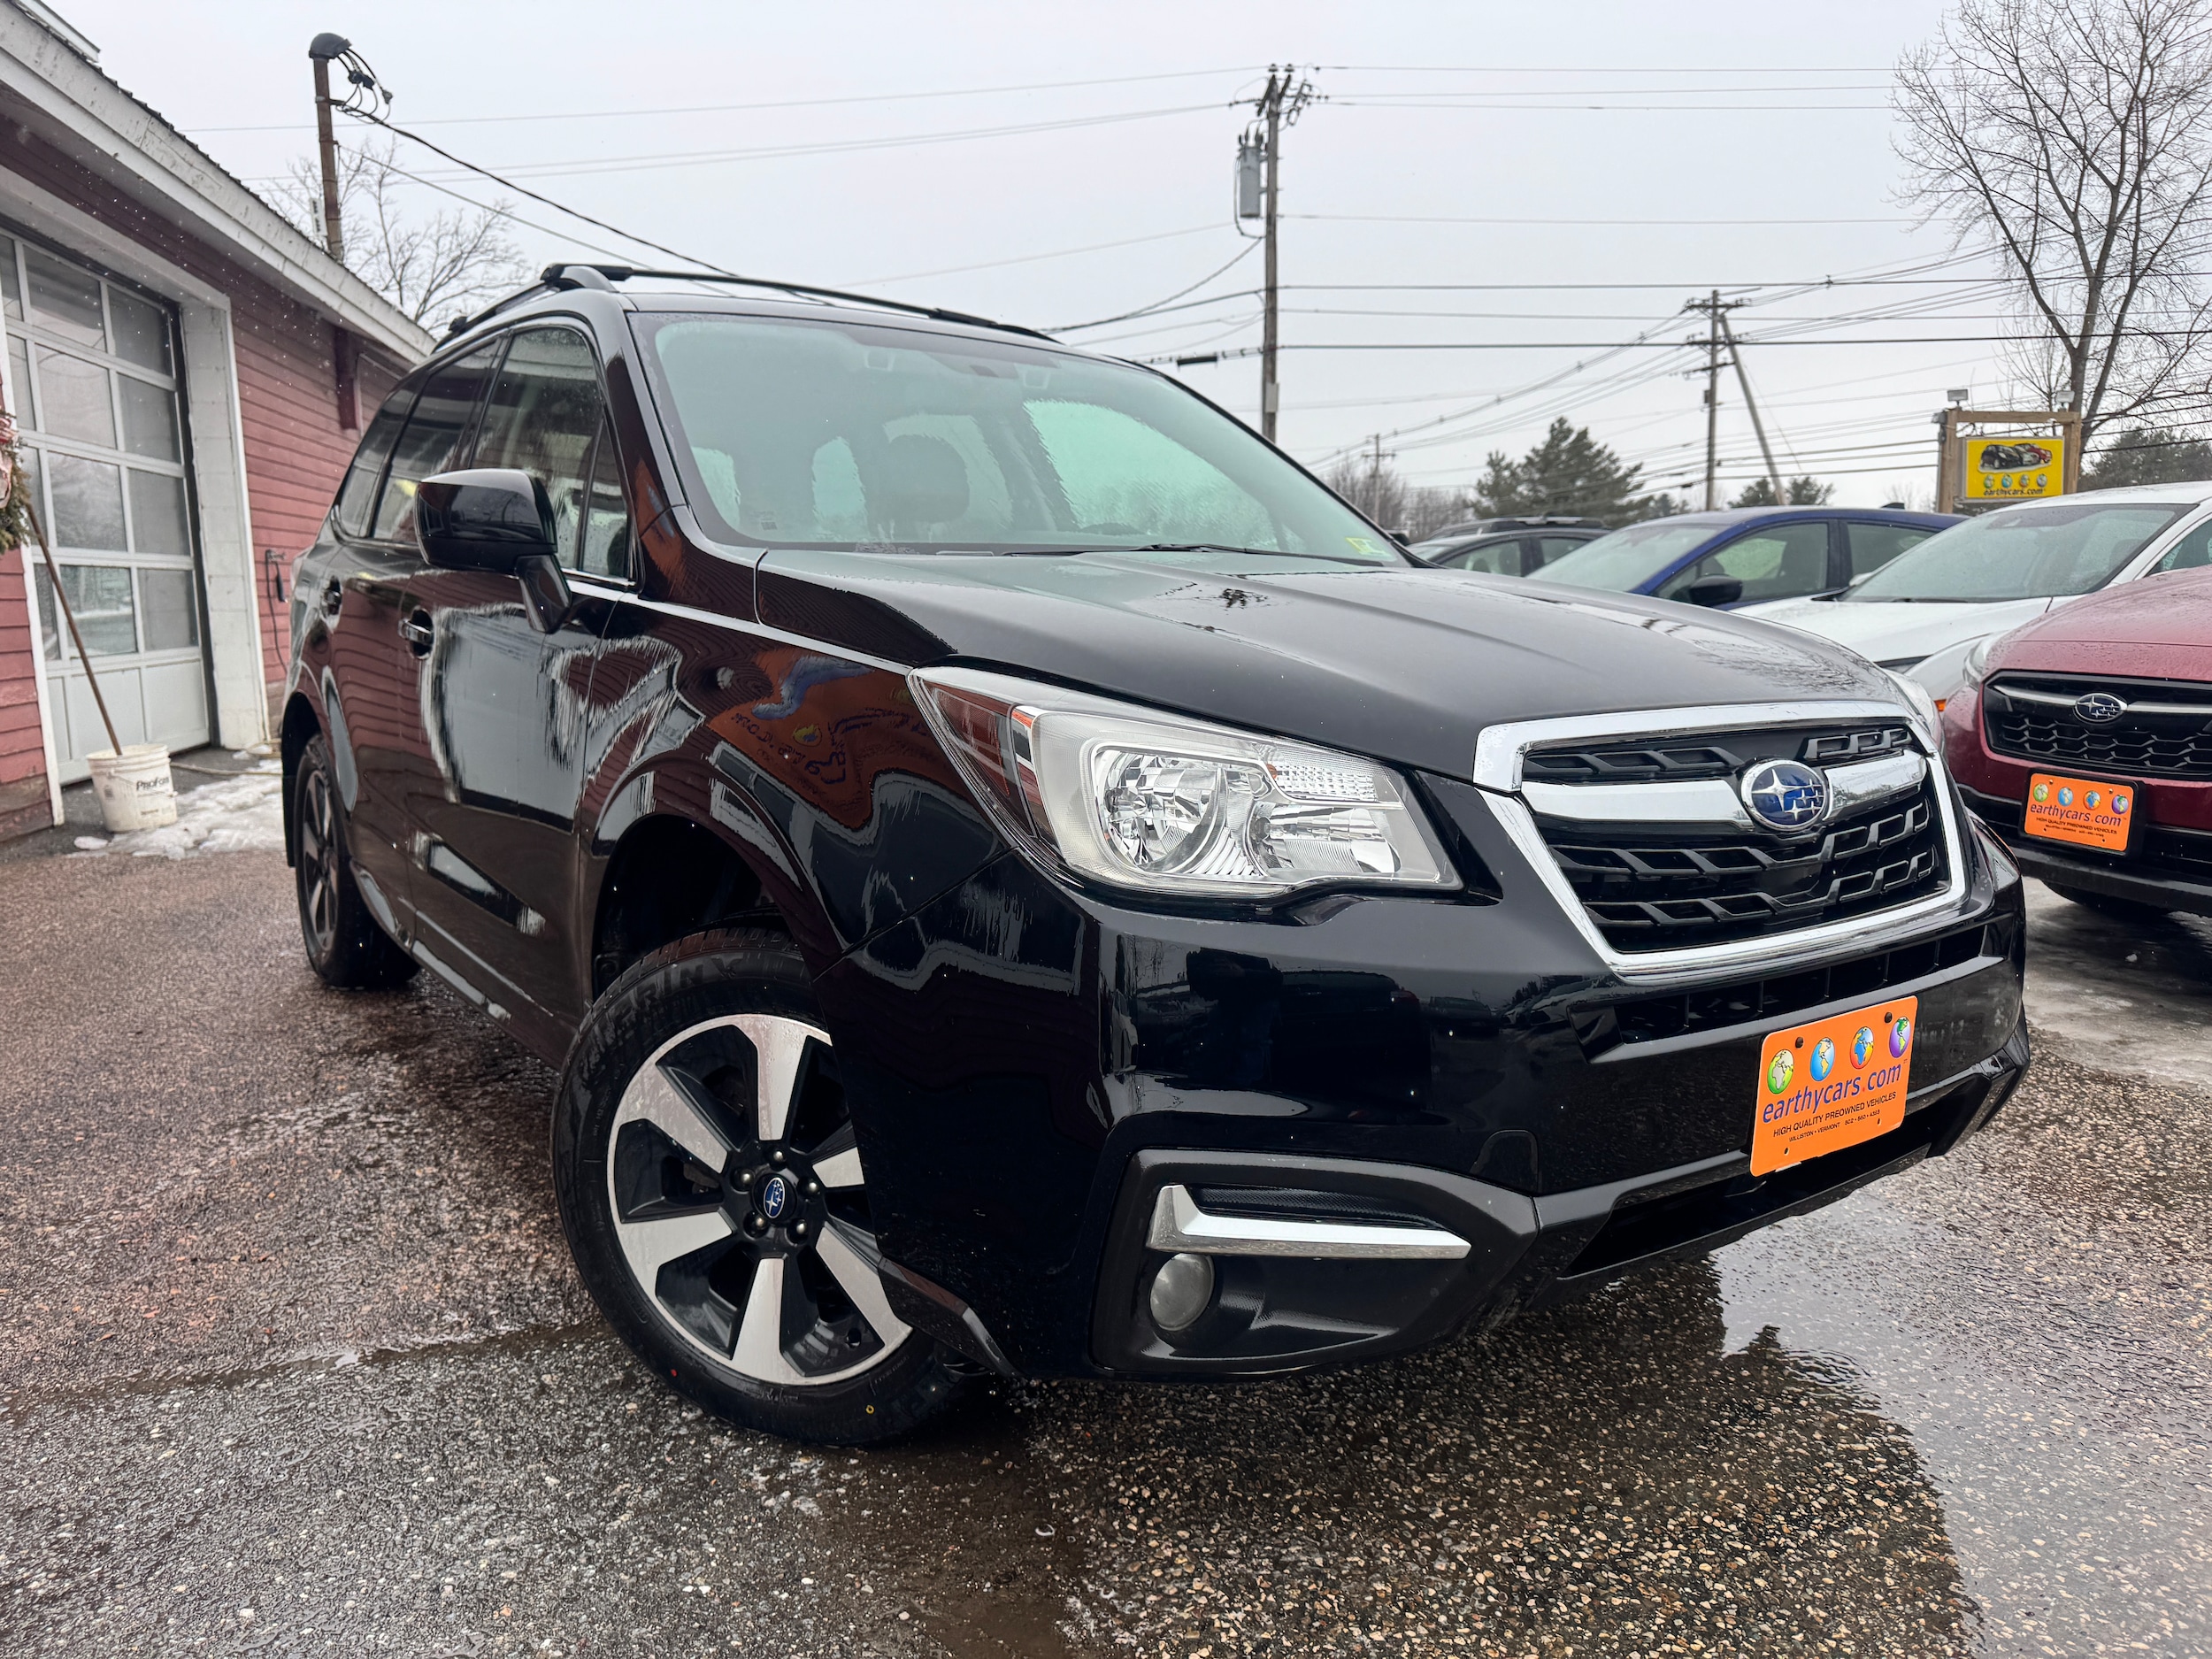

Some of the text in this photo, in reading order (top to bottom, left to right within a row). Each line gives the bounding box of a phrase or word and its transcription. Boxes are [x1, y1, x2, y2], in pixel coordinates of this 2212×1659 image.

[2030, 803, 2122, 826] earthycars.com
[1763, 1064, 1901, 1124] earthycars.com
[1773, 1091, 1897, 1138] HIGH QUALITY PREOWNED VEHICLES
[1817, 1122, 1840, 1133] VERMONT
